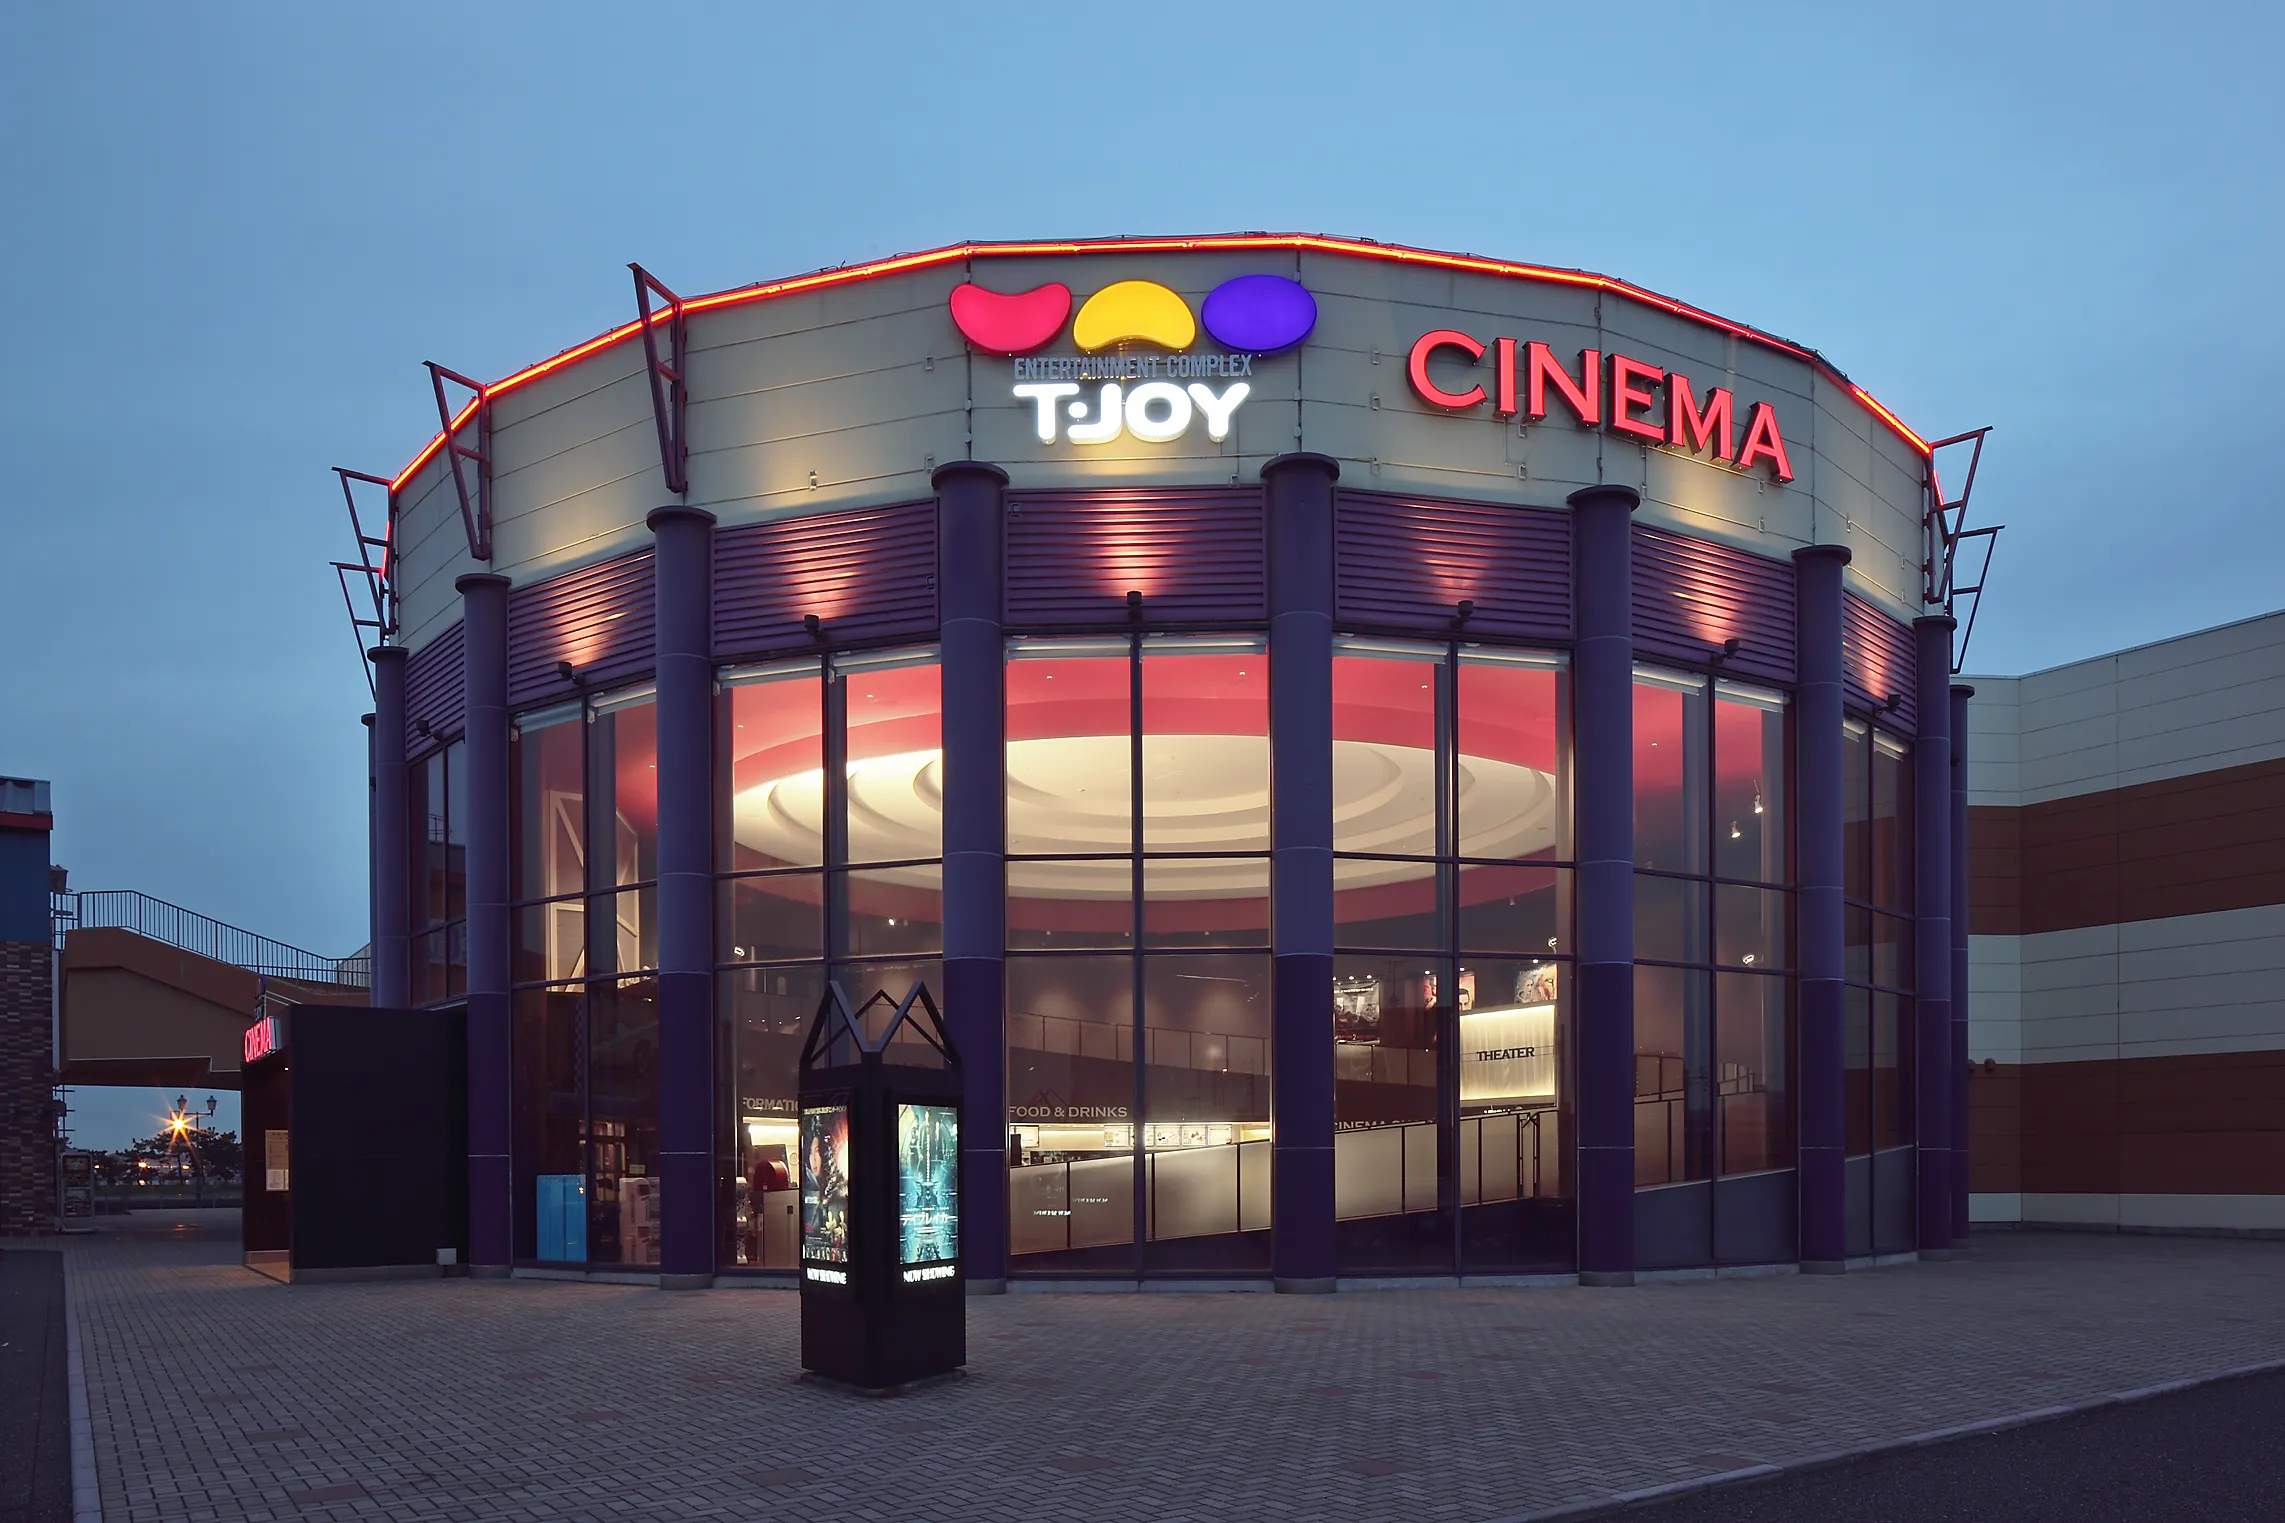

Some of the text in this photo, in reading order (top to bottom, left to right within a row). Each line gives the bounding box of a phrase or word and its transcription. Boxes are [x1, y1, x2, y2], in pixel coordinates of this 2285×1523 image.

[1013, 353, 1253, 381] ENTERTAINMENT COMPLEX
[1407, 329, 1795, 484] CINEMA
[244, 1016, 273, 1063] CINEMA
[1477, 1046, 1535, 1062] THEATER
[1009, 1106, 1127, 1118] FOOD & DRINKS
[903, 1265, 955, 1283] NOW SHOWING
